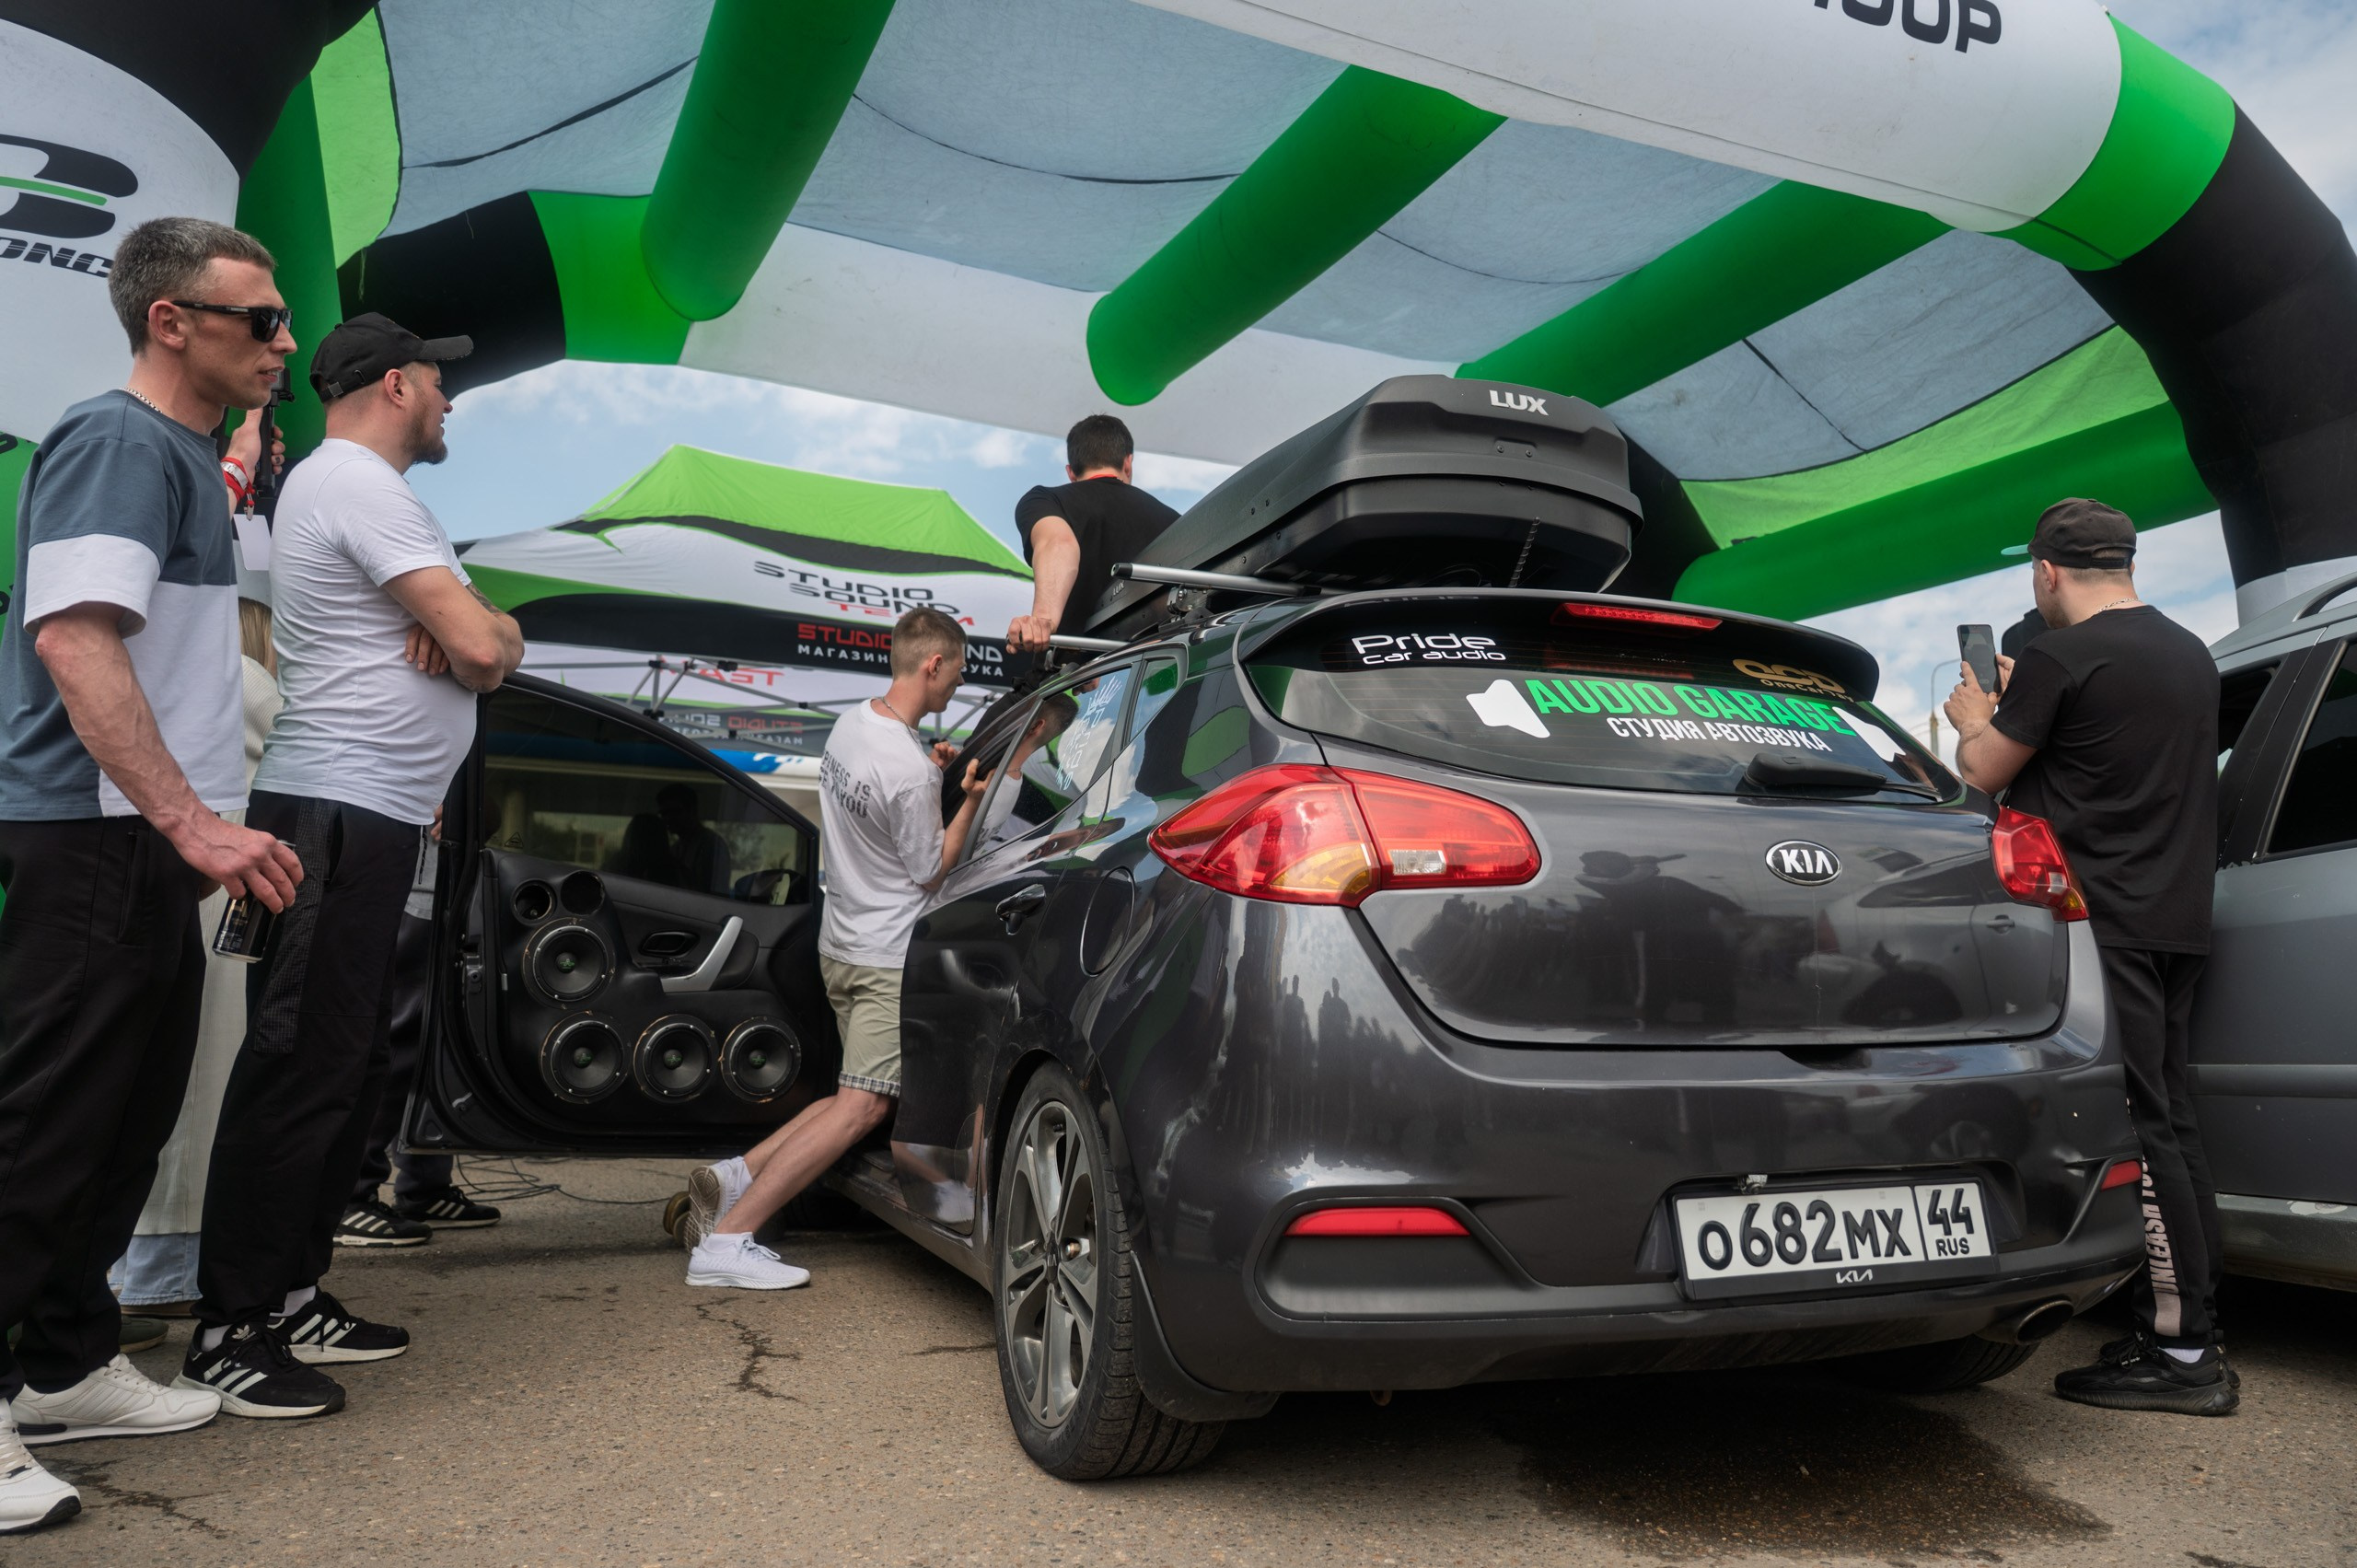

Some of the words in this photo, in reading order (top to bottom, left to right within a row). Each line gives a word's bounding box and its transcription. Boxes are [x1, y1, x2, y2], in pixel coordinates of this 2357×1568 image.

[1489, 389, 1550, 416] LUX
[753, 561, 934, 600] STUDIO
[797, 645, 888, 665] МАГАЗИН
[1352, 633, 1497, 655] Pride
[1363, 652, 1412, 665] car
[1422, 650, 1507, 661] audio
[1524, 679, 1678, 715] AUDIO
[1673, 685, 1858, 737] GARAGE
[1606, 717, 1708, 741] СТУДИЯ
[1702, 722, 1833, 752] АВТОЗВУКА
[1778, 849, 1835, 875] KIA
[1926, 1188, 1975, 1237] 44
[1935, 1237, 1971, 1258] RUS
